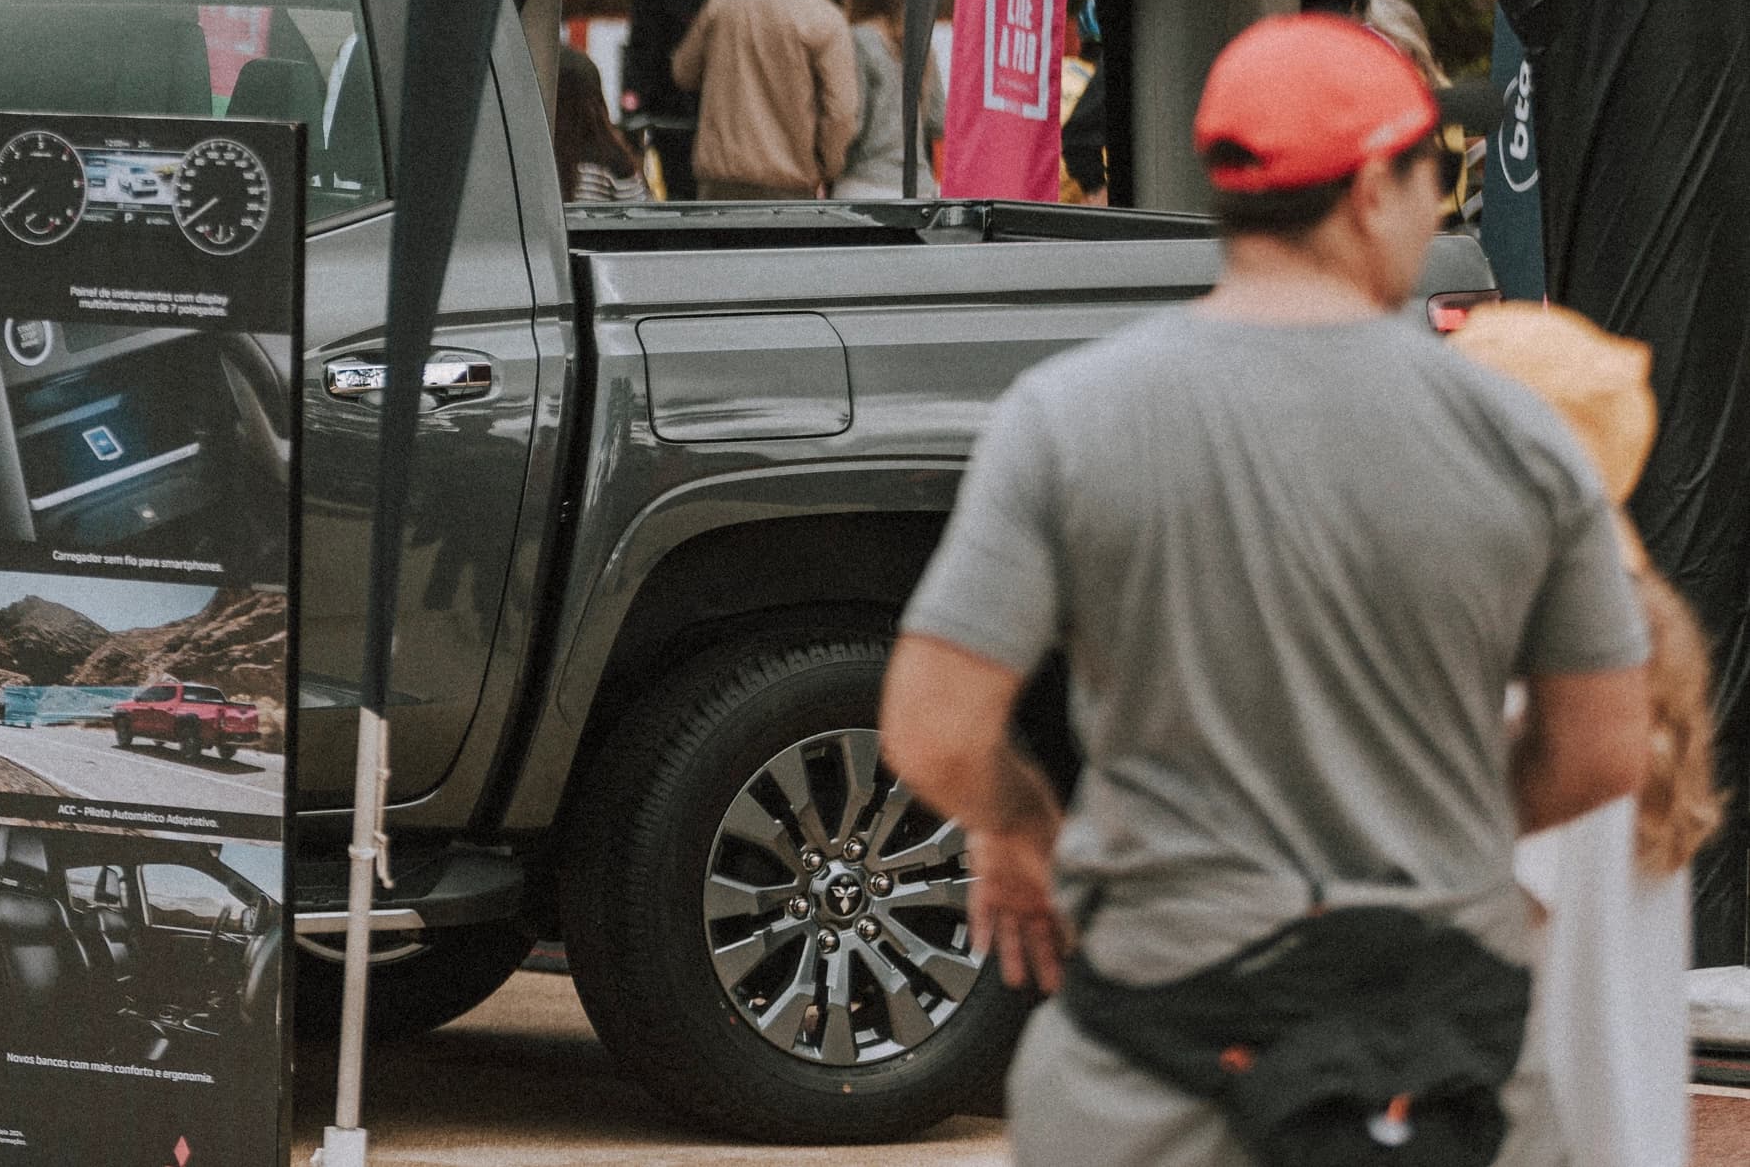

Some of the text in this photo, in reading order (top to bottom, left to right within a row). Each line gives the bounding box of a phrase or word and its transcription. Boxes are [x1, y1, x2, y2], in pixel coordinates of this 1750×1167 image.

[70, 287, 229, 305] Painel de instrumentos com display
[156, 303, 169, 313] de
[170, 304, 177, 312] 7
[52, 550, 102, 563] Carregador
[103, 556, 123, 564] sem
[124, 555, 138, 566] fio
[138, 558, 159, 568] para
[57, 805, 76, 815] ACC
[84, 807, 110, 818] Piloto
[111, 810, 165, 823] Automático
[6, 1053, 35, 1064] Novos
[35, 1055, 69, 1067] bancos
[70, 1061, 89, 1069] com
[90, 1062, 113, 1072] mais
[114, 1065, 154, 1076] conforto
